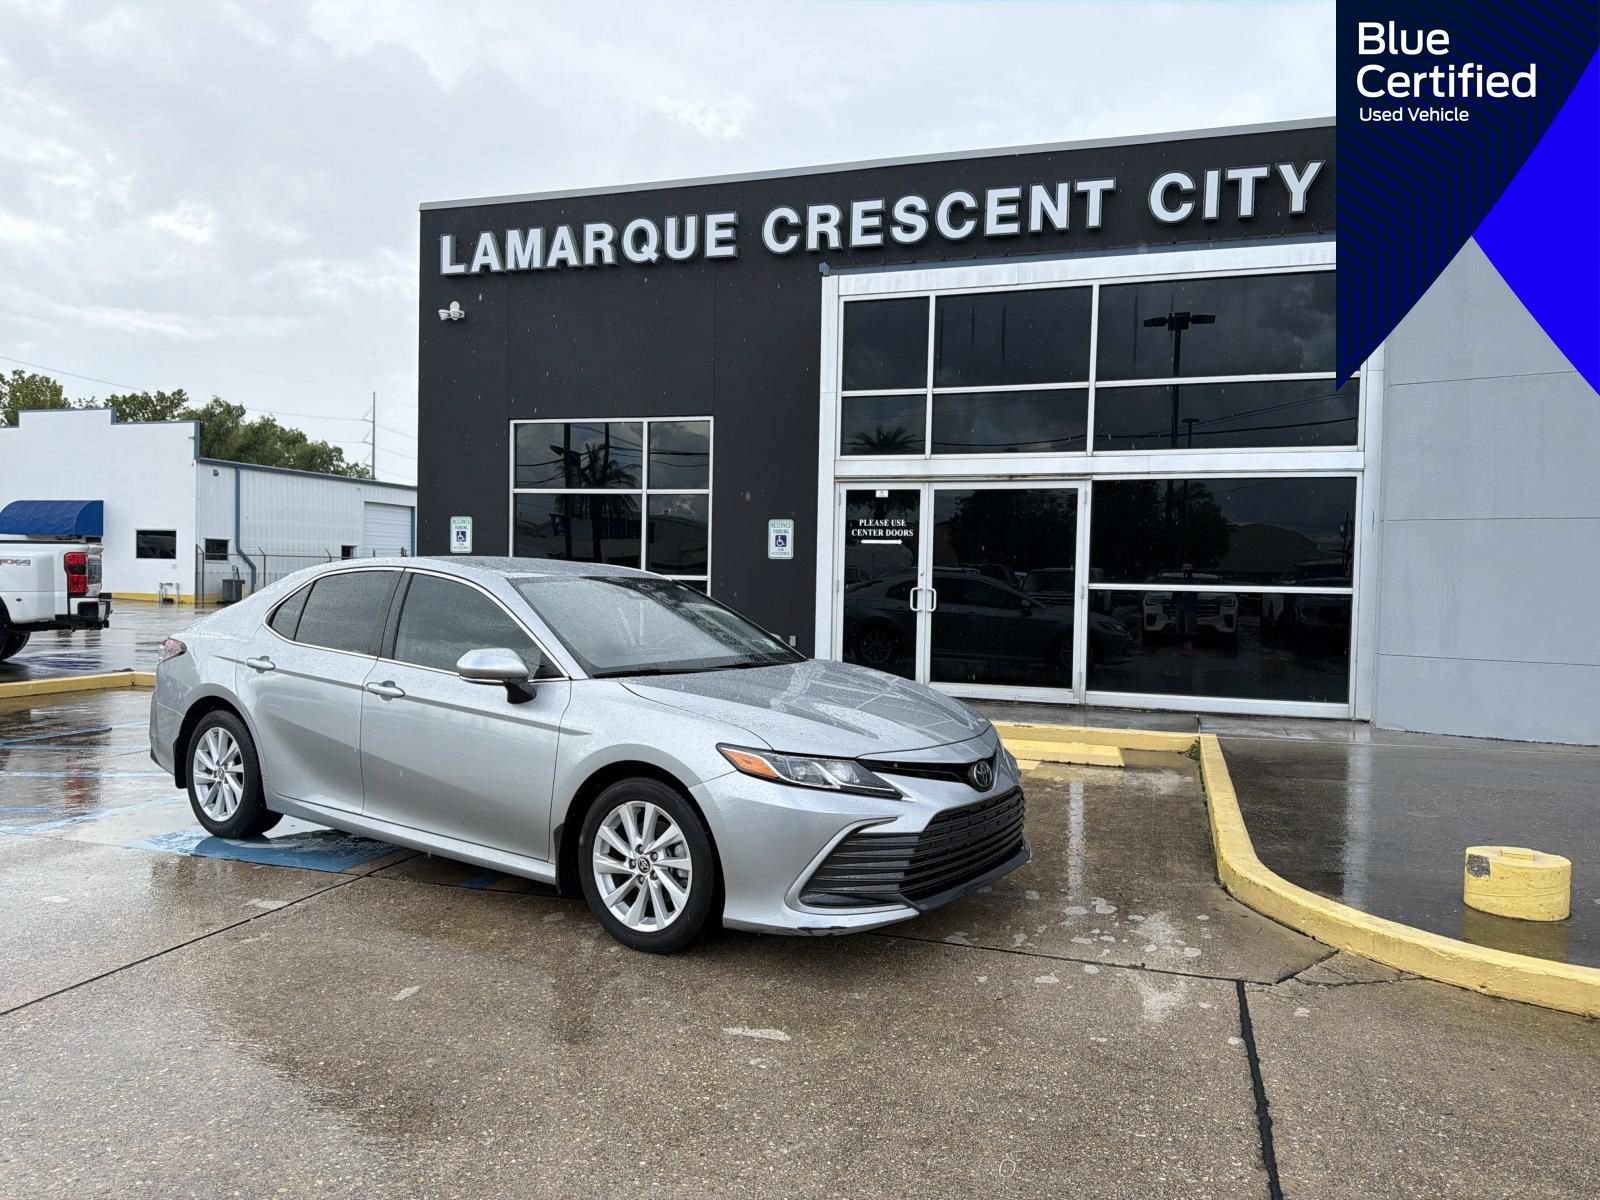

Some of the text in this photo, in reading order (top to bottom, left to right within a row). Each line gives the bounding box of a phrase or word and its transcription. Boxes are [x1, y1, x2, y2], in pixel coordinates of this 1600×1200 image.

[440, 160, 1326, 276] LAMARQUE CRESCENT CITY
[859, 519, 907, 527] PLEASE USE
[851, 529, 914, 537] CENTER DOORS
